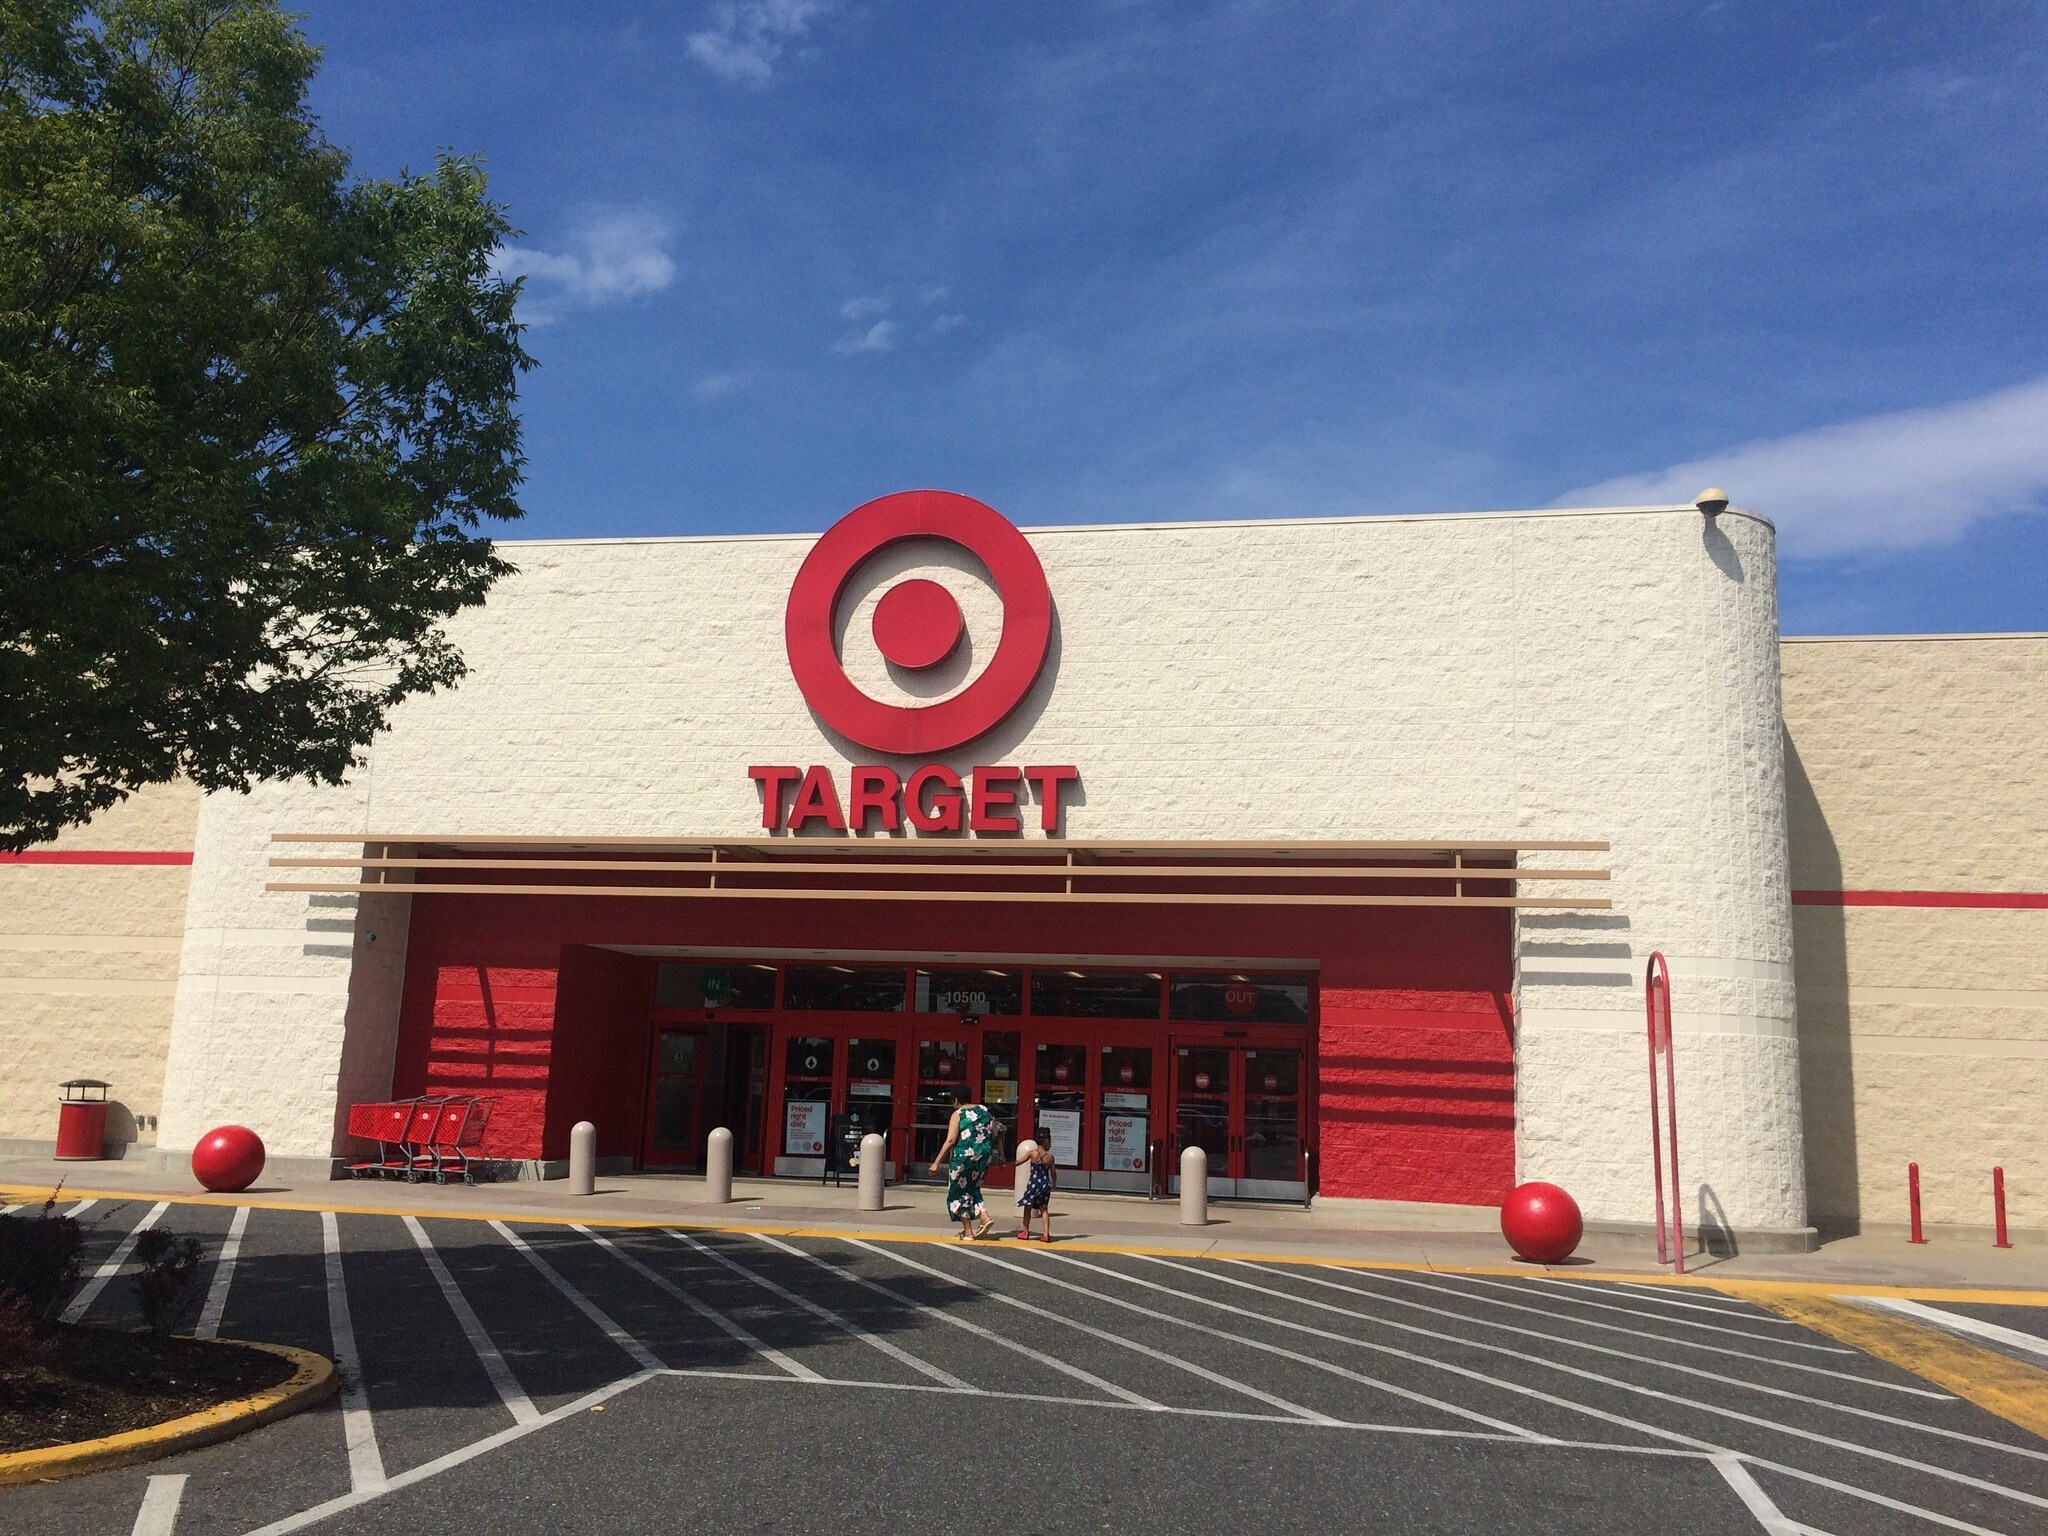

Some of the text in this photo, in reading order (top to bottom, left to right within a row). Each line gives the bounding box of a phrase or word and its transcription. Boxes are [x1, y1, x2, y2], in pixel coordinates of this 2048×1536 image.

[748, 764, 1078, 832] TARGET
[707, 979, 720, 989] IN
[946, 991, 986, 1003] 10500
[1225, 990, 1255, 1003] OUT
[790, 1113, 806, 1121] right
[790, 1121, 806, 1129] daily
[1108, 1127, 1125, 1136] right
[1108, 1136, 1126, 1144] daily
